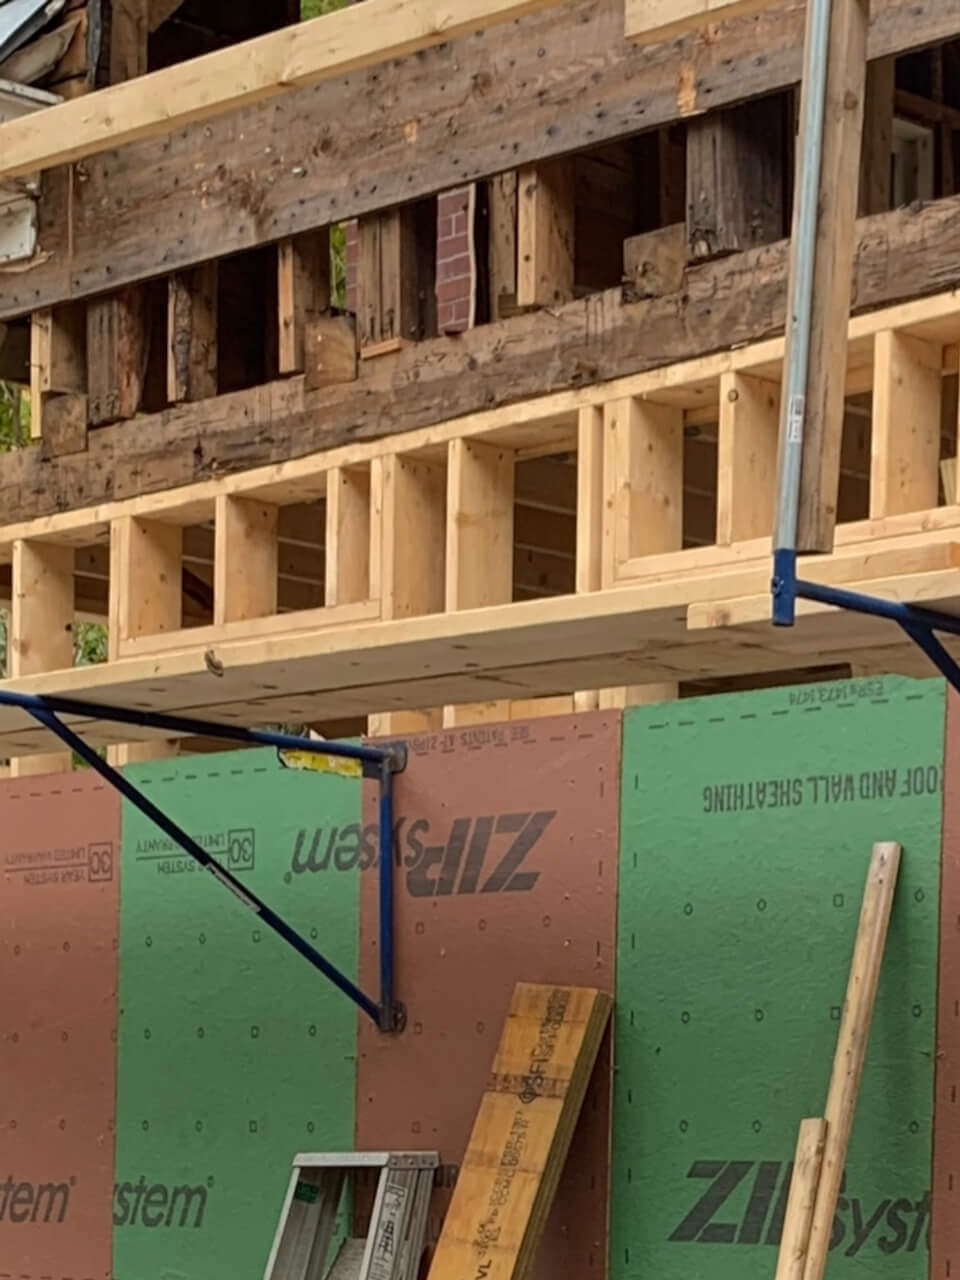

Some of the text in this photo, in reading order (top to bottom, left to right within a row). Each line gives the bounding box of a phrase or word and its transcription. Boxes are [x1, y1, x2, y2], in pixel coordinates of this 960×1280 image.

[702, 765, 943, 813] OOF AND WALL SHEATHING
